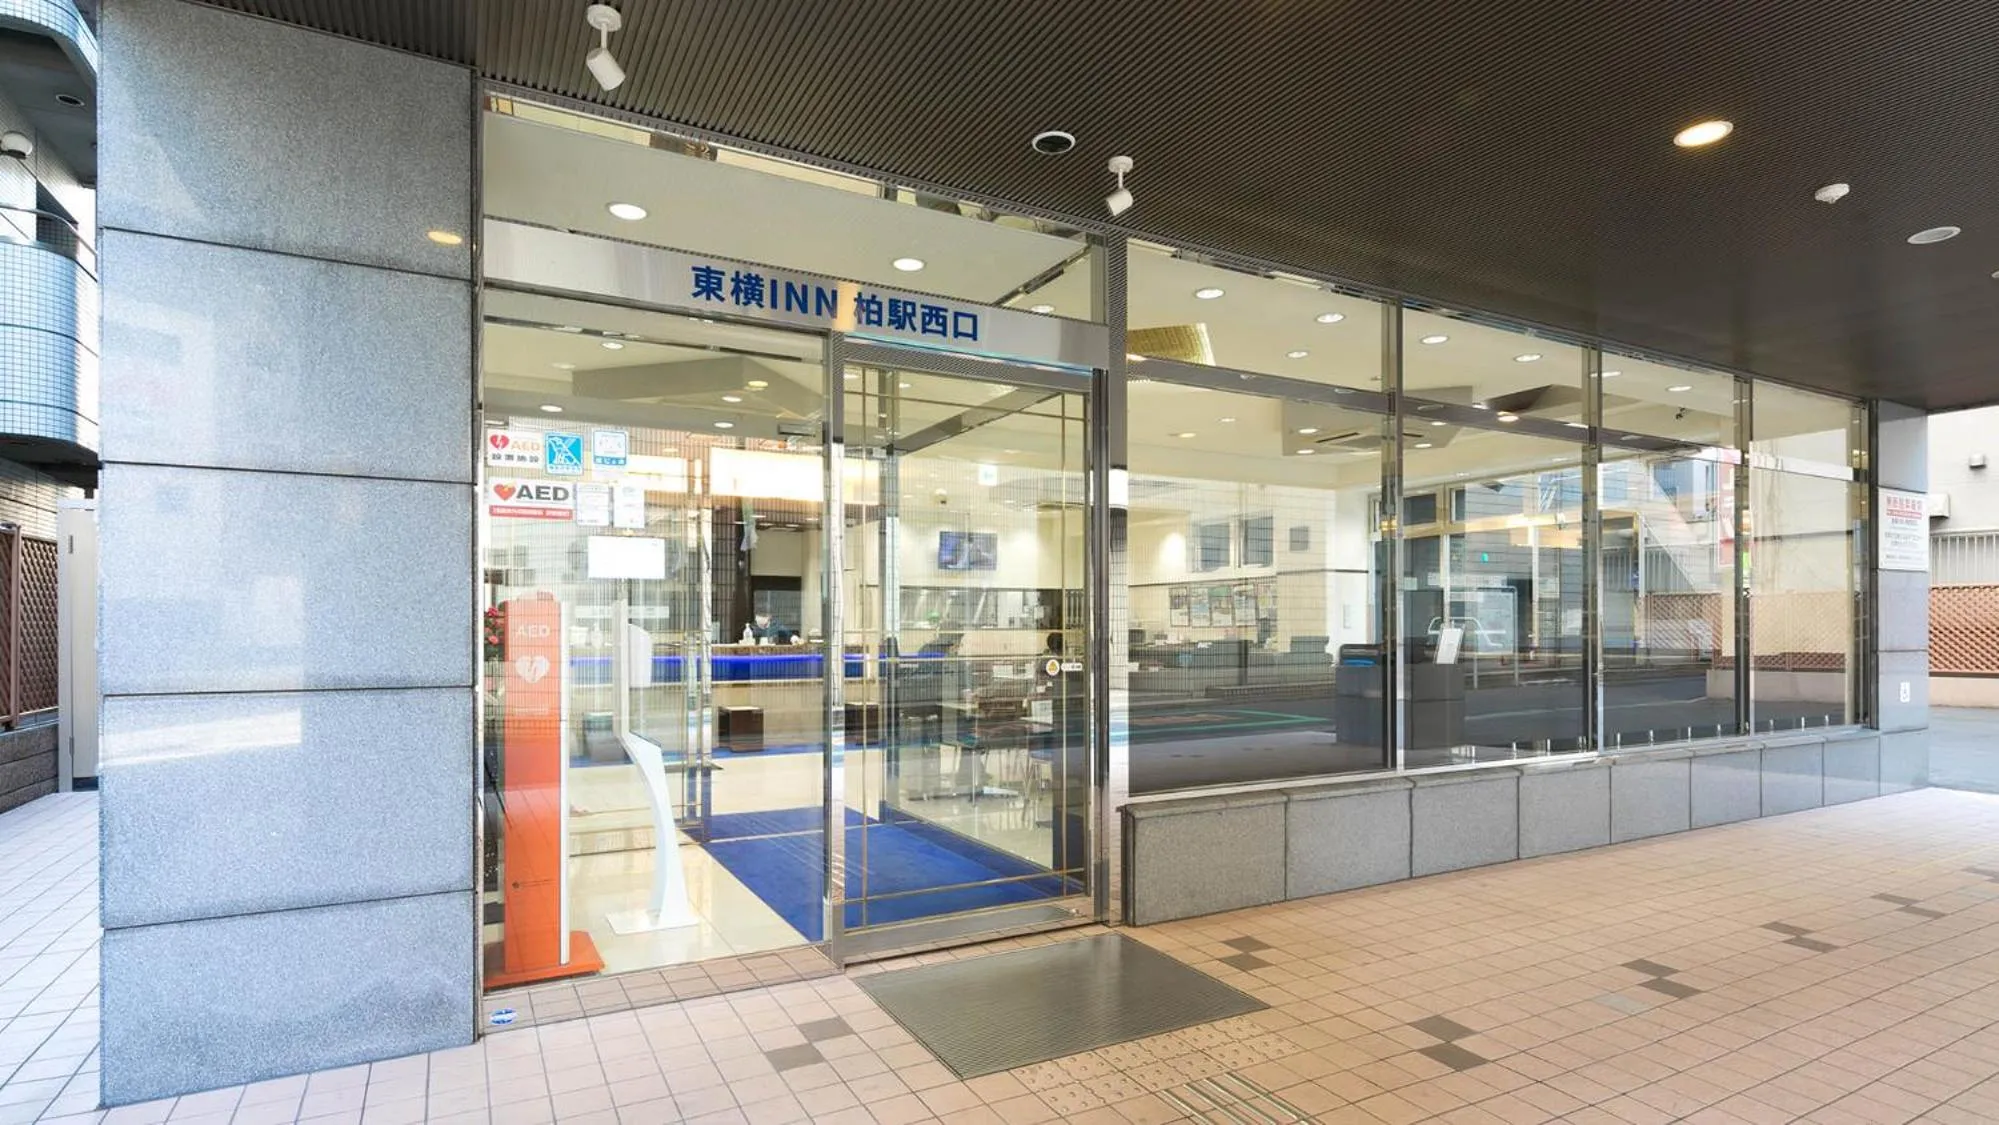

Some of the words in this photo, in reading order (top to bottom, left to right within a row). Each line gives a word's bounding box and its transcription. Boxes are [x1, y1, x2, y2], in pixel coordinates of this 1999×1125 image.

[691, 265, 838, 320] 東横INN
[853, 291, 979, 341] 柏駅西口
[511, 440, 540, 452] AED
[516, 484, 570, 502] AED
[518, 624, 550, 638] AED
